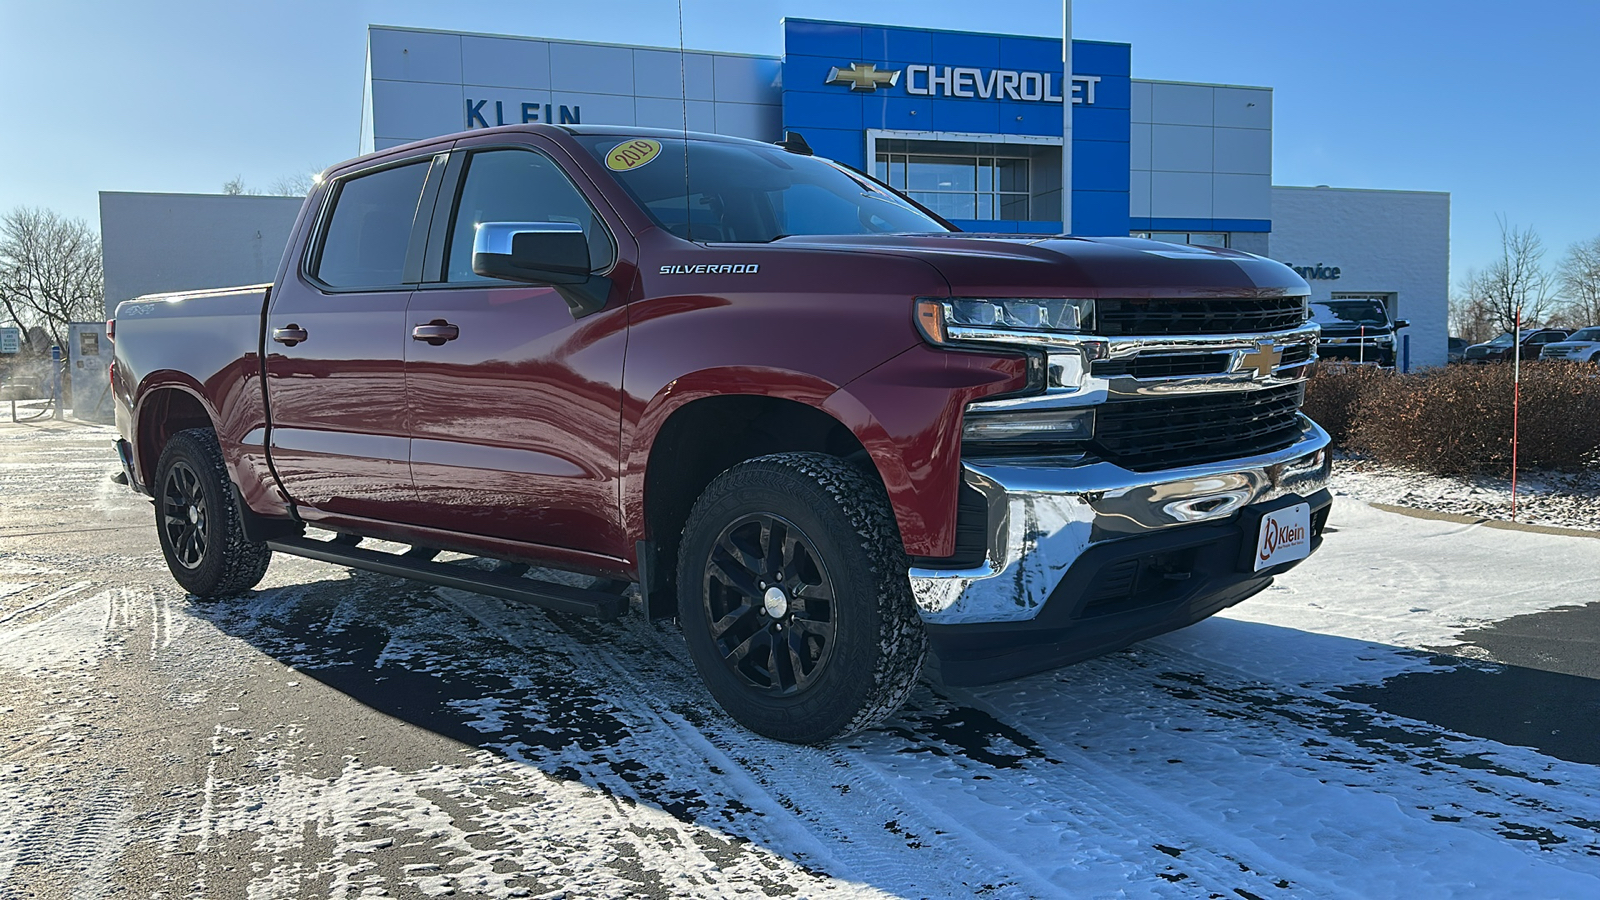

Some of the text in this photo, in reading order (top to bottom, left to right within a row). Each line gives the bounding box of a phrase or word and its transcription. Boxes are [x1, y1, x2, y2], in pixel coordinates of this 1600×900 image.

[906, 64, 1101, 104] CHEVROLET
[466, 98, 581, 128] KLEIN
[614, 141, 653, 167] 2019
[659, 264, 760, 275] SILVERADO
[1278, 523, 1305, 545] Klein
